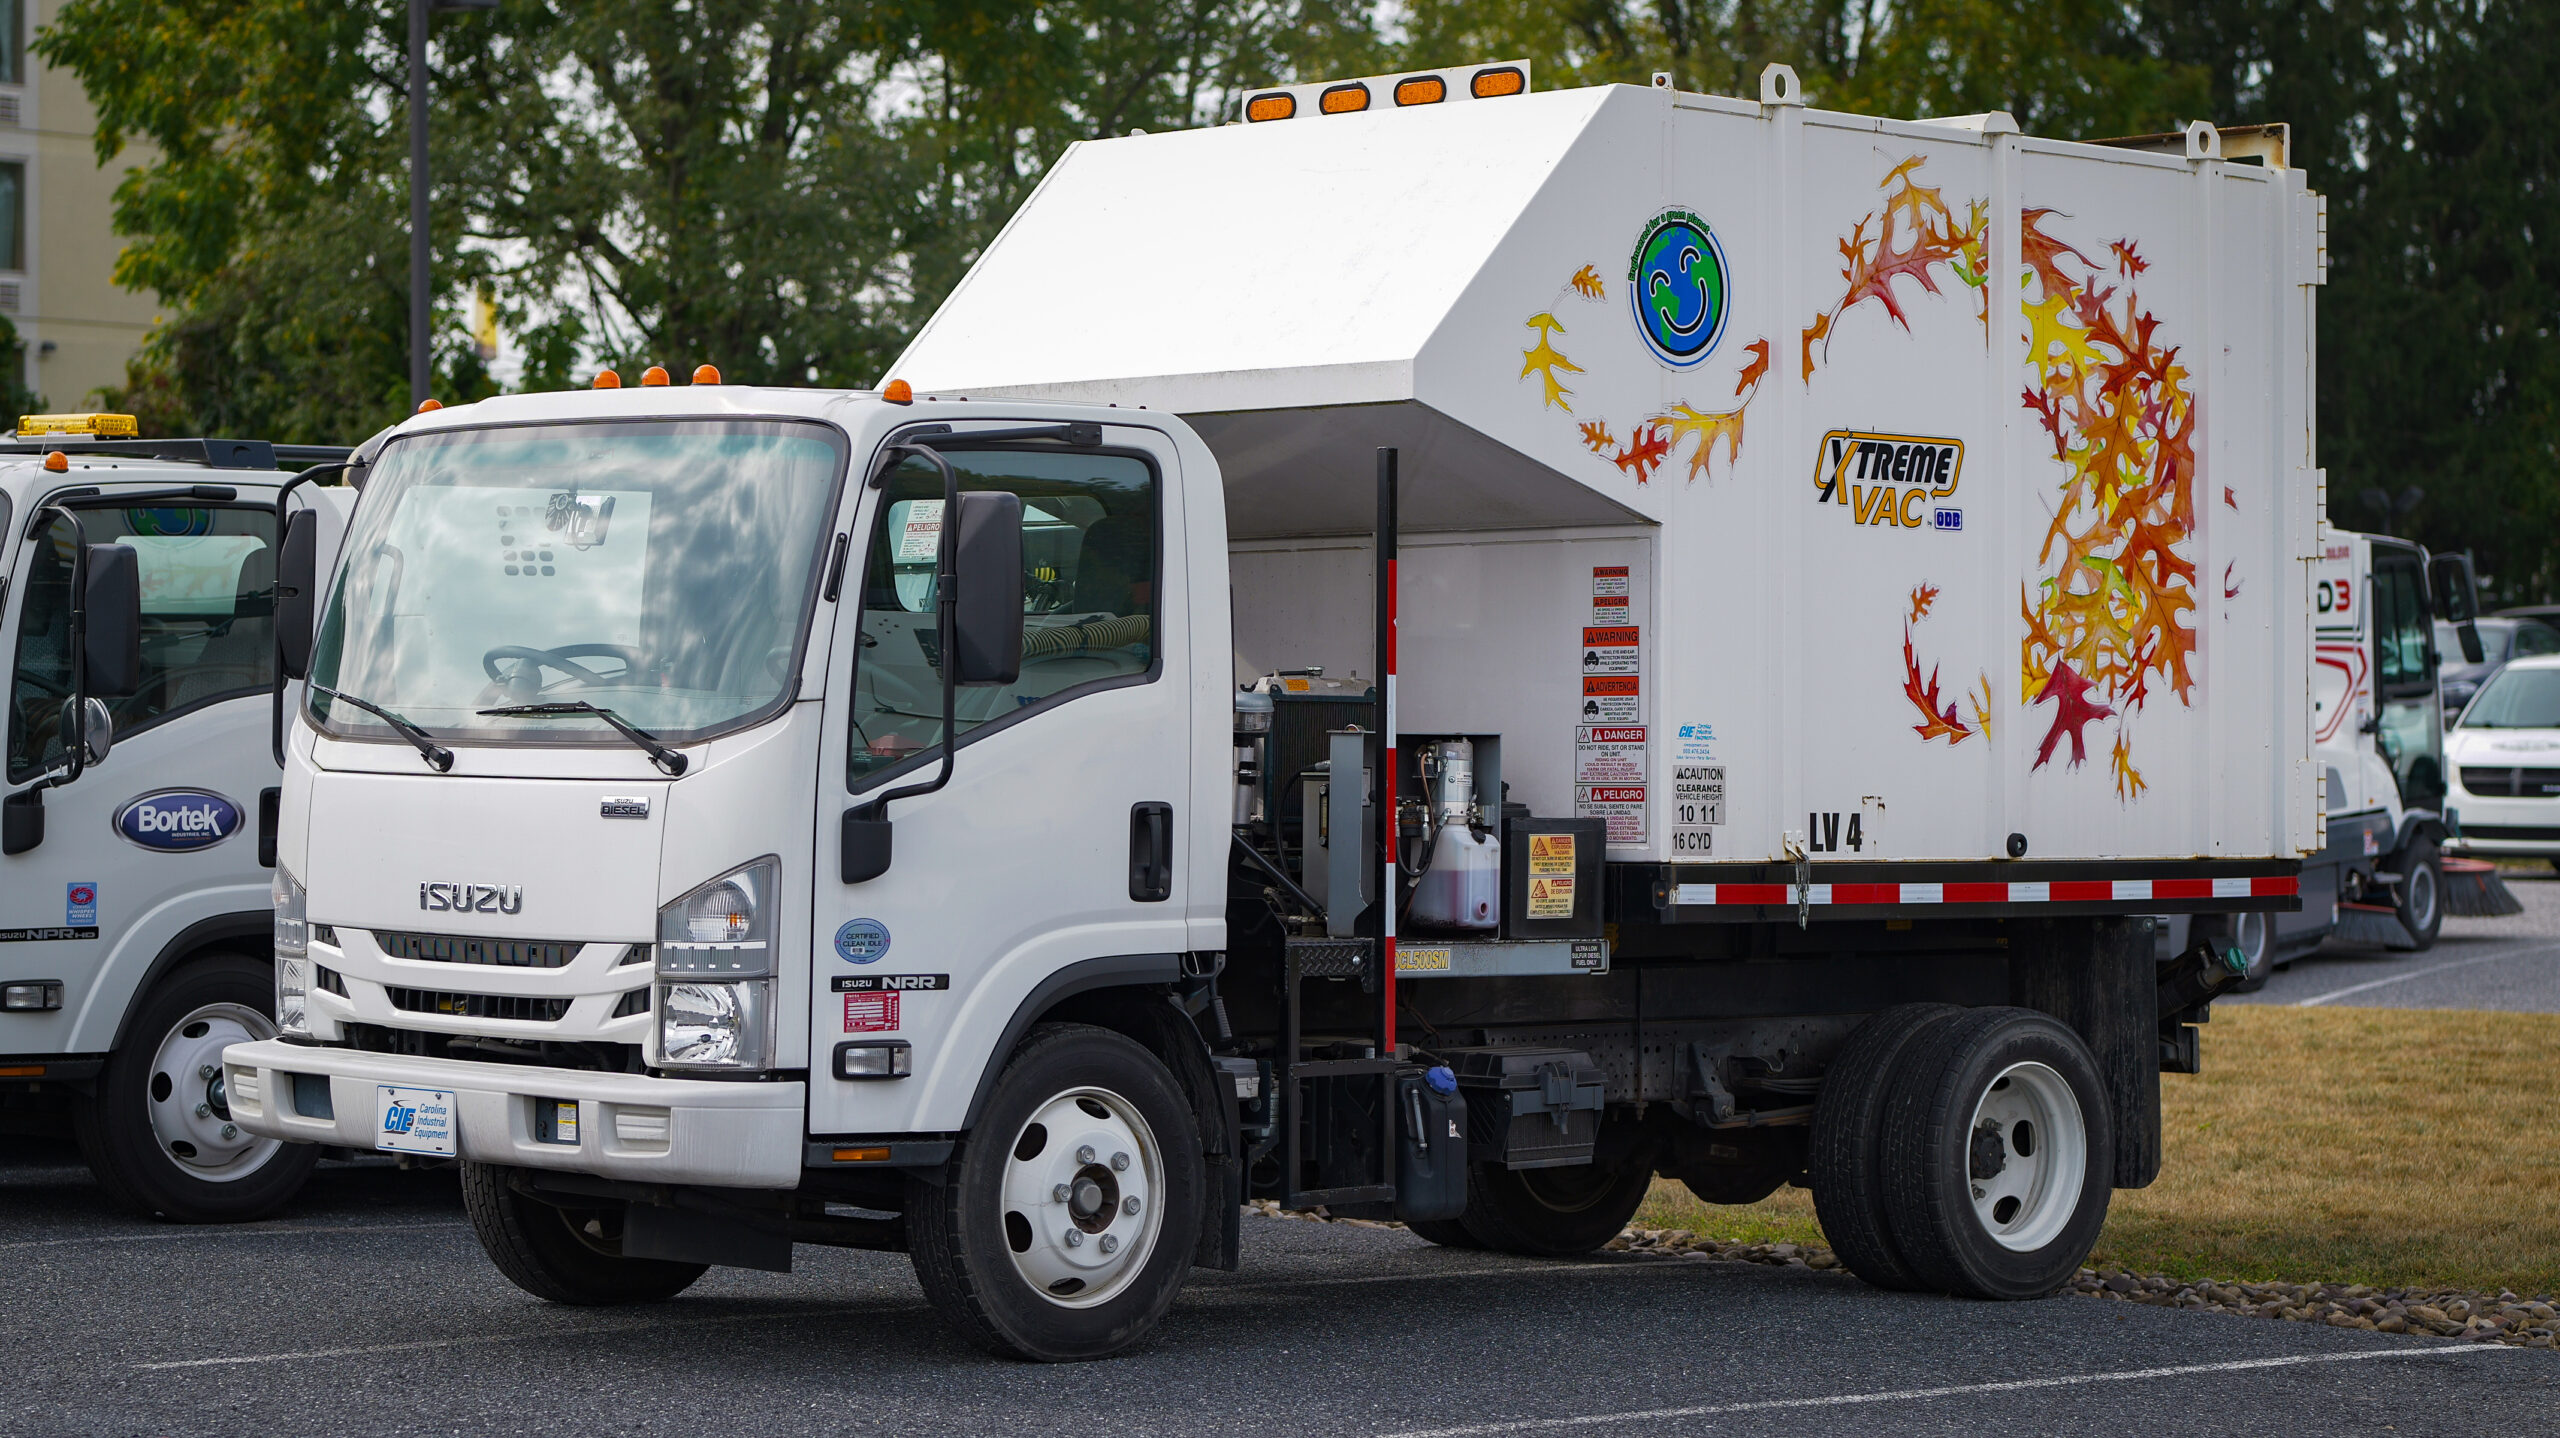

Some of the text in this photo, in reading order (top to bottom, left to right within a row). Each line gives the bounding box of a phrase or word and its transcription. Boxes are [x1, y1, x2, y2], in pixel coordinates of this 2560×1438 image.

[1648, 216, 1661, 231] for
[1660, 213, 1667, 222] a
[1666, 211, 1686, 223] green
[1687, 212, 1710, 235] planet
[1818, 439, 1953, 504] XTREME
[1853, 485, 1927, 528] VAC
[1937, 512, 1960, 527] ODB
[913, 523, 940, 531] PELIGRO
[1596, 631, 1638, 642] WARNING
[1596, 682, 1636, 691] ADVERTENCIA
[1604, 730, 1643, 740] DANGER
[1679, 726, 1696, 737] CIE
[1684, 768, 1723, 780] CAUTION
[1604, 790, 1643, 799] PELIGRO
[1676, 784, 1722, 793] CLEARANCE
[603, 806, 643, 814] DIESEL
[138, 804, 222, 836] Bortek
[1810, 813, 1862, 852] LV 4
[1673, 832, 1711, 850] 16 CYD
[420, 881, 522, 915] ISUZU
[27, 929, 74, 939] NPR
[842, 976, 935, 989] ISUZU NRR
[420, 1103, 447, 1115] Carolina
[385, 1107, 416, 1132] CIE
[417, 1116, 447, 1127] Industrial
[414, 1127, 448, 1140] Equipment
